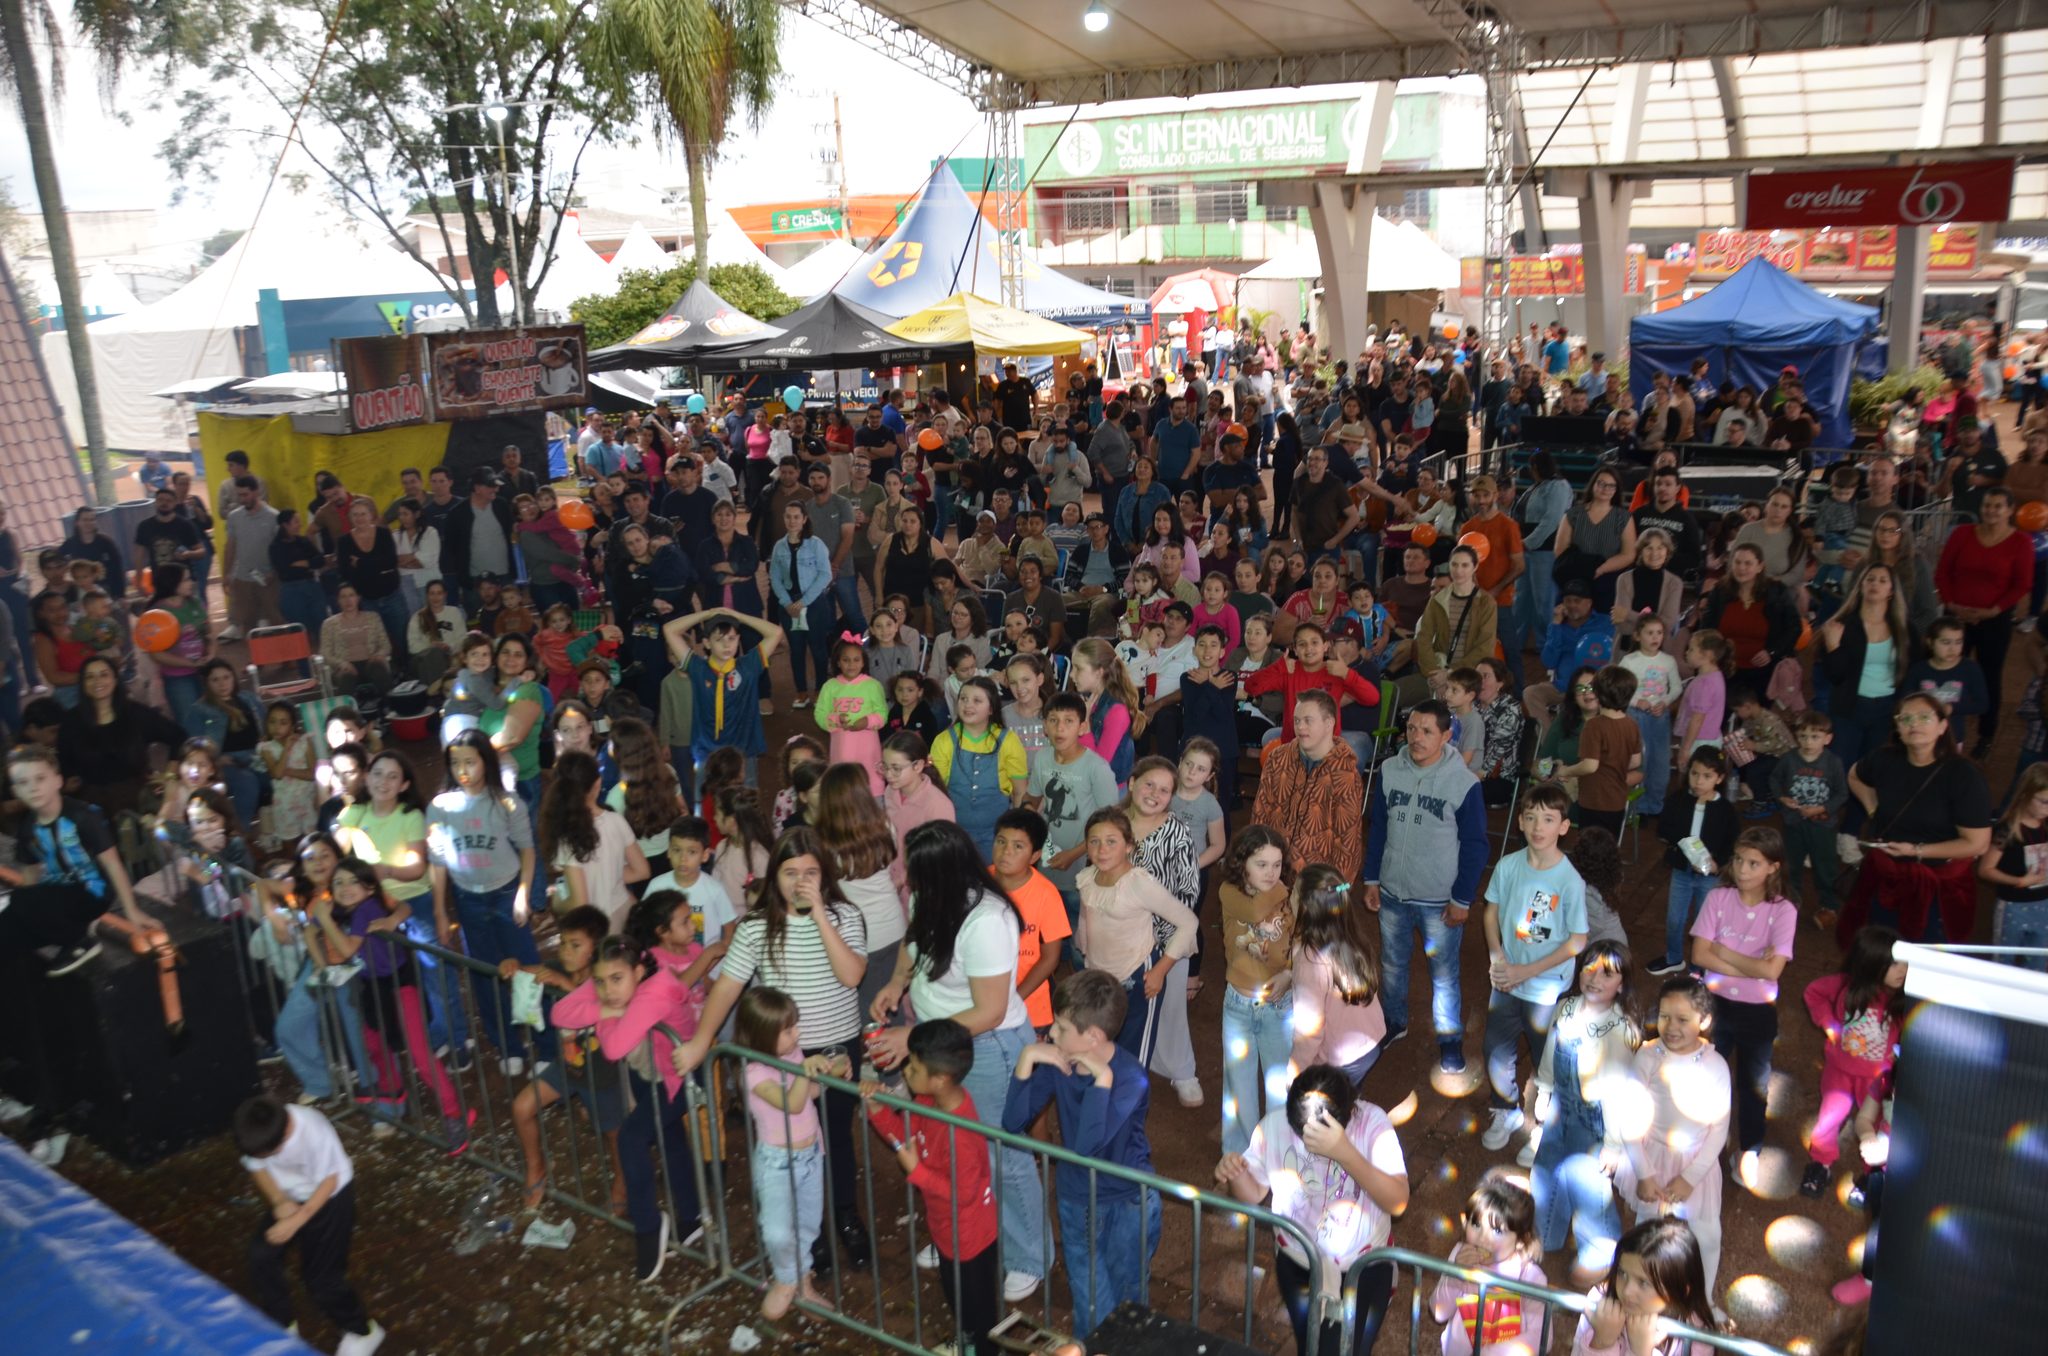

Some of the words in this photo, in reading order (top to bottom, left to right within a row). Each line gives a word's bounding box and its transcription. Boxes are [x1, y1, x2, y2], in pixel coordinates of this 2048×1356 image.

[1147, 110, 1328, 154] INTERNACIONAL
[1118, 153, 1186, 171] CONSULADO
[1188, 149, 1236, 166] OFICIAL
[1238, 147, 1257, 163] DE
[1784, 182, 1870, 210] creluz
[481, 364, 543, 390] CHOCOLATE
[354, 373, 425, 430] QUENTÃO
[495, 384, 537, 405] QUENTE
[832, 696, 865, 713] YES
[1387, 788, 1413, 810] NEW
[1417, 793, 1448, 822] YORK
[452, 834, 498, 852] FREE
